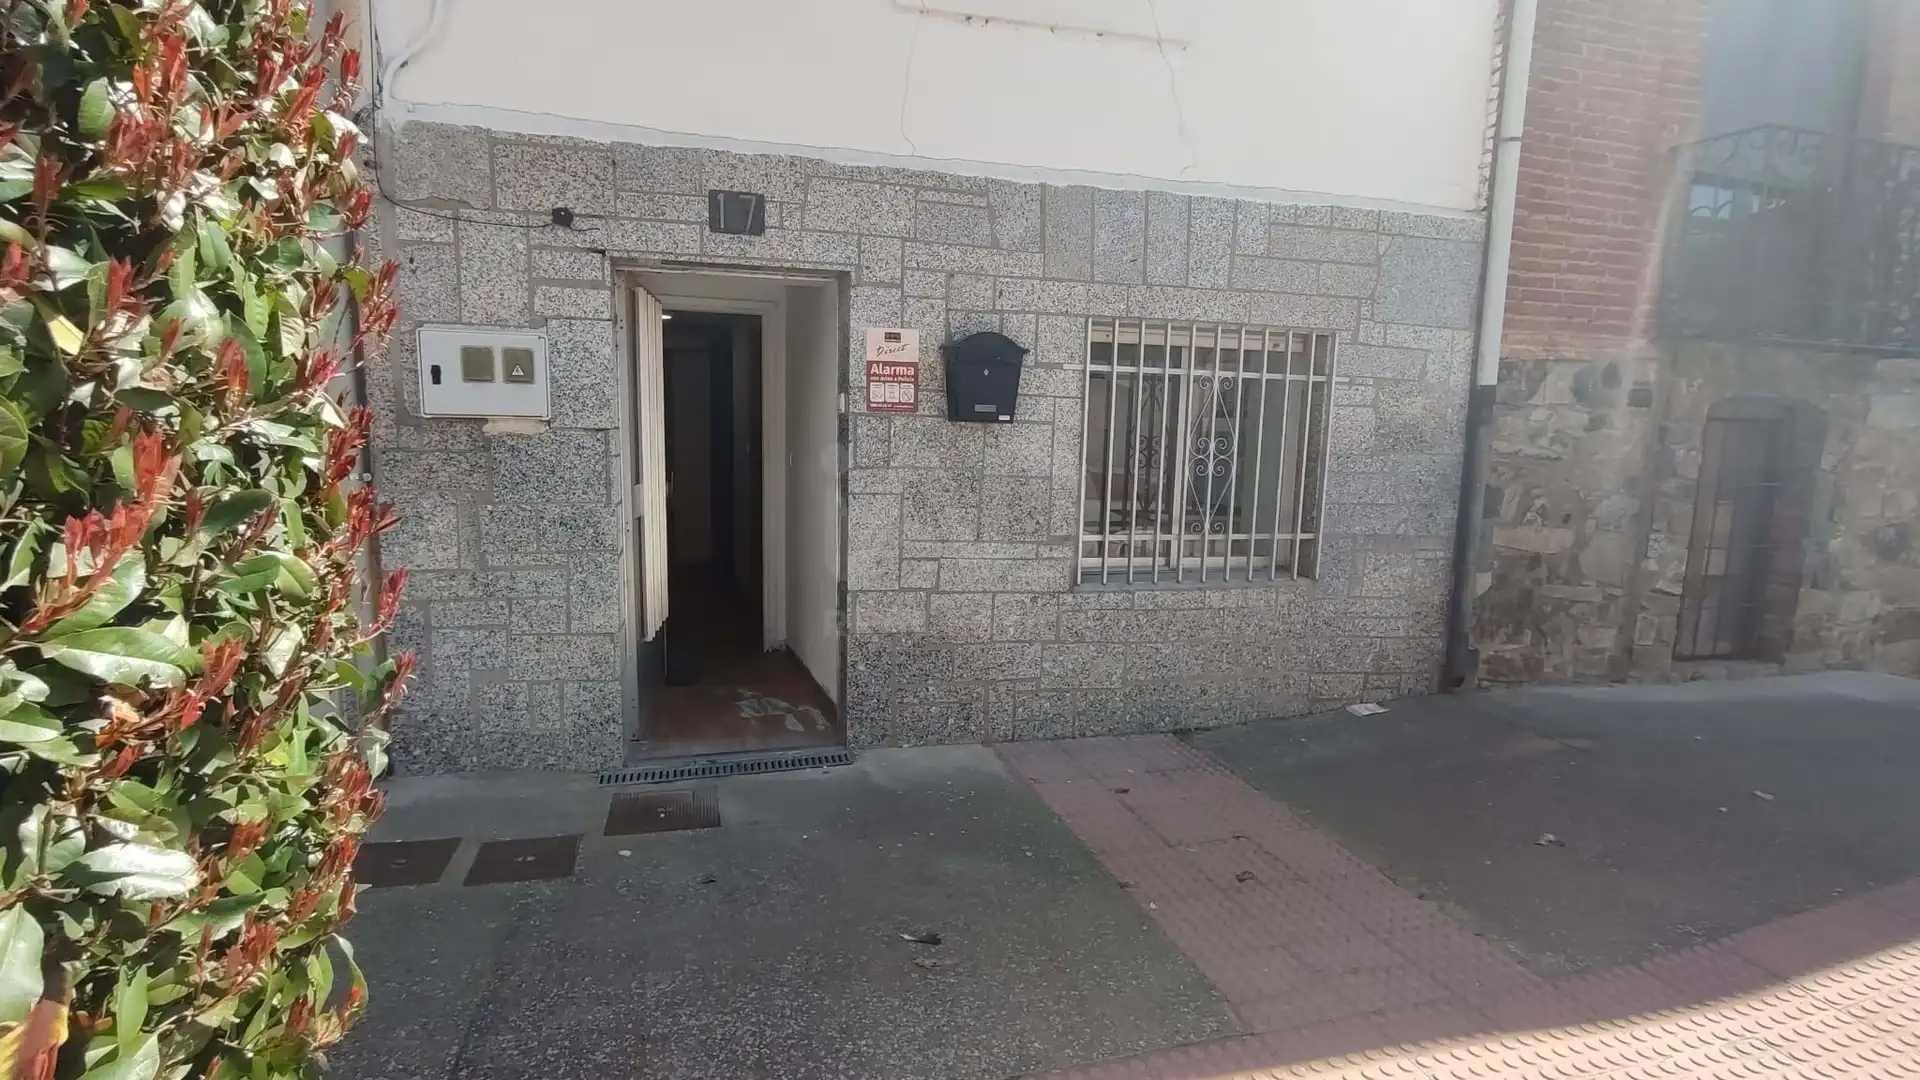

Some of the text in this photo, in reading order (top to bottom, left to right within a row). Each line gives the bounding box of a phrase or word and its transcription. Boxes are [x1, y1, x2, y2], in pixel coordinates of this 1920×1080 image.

[716, 192, 756, 232] 17
[876, 343, 910, 358] Direct
[870, 362, 915, 376] Alarma
